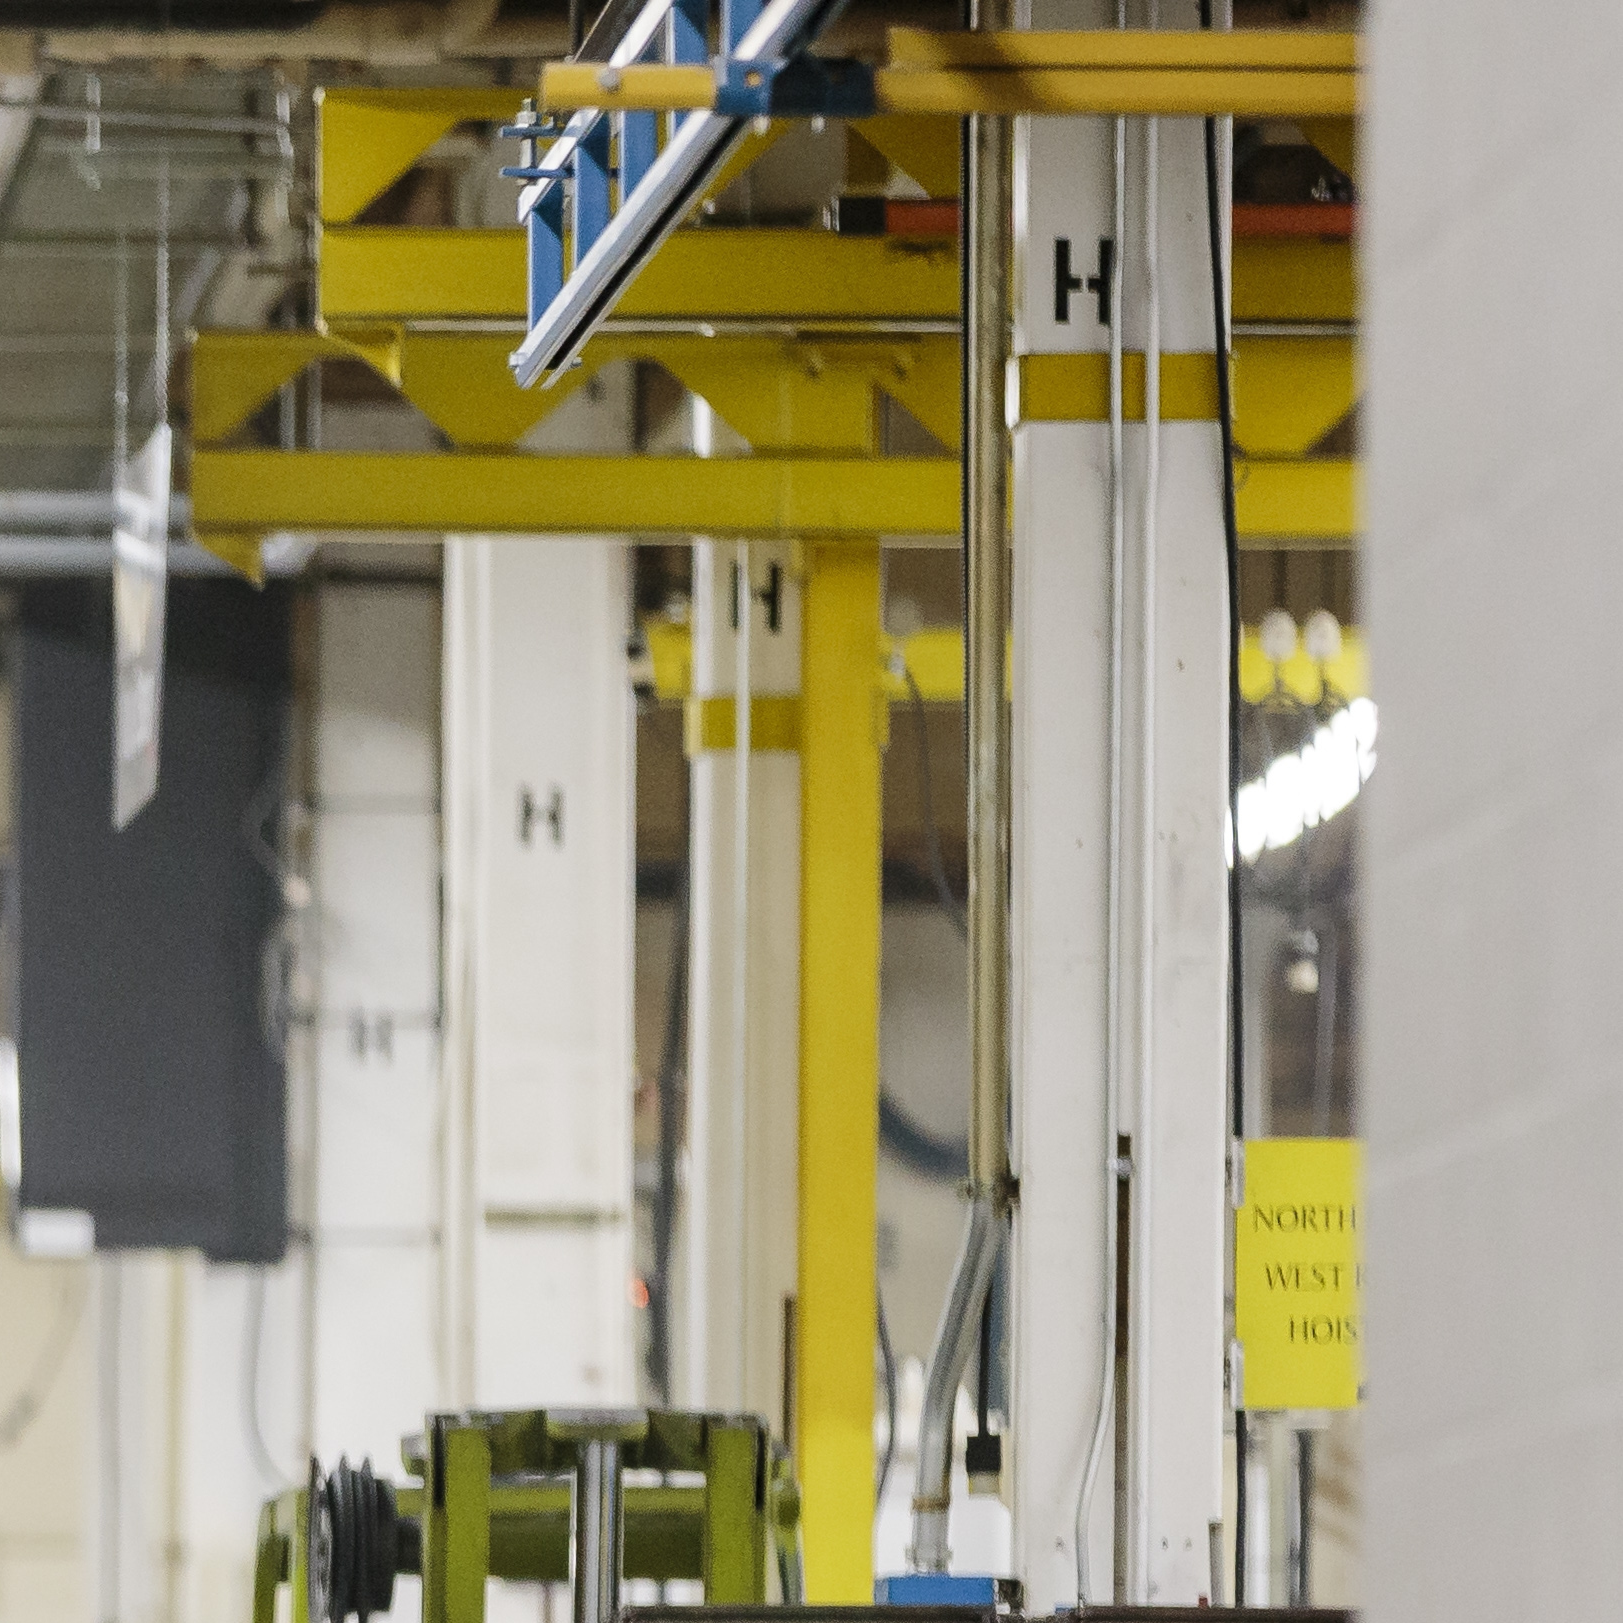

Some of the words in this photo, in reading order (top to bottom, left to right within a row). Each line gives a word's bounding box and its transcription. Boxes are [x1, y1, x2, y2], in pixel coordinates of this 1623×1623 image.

[1053, 238, 1114, 325] H
[514, 780, 565, 853] H
[1252, 1203, 1357, 1233] NORTH
[1264, 1262, 1345, 1292] WEST
